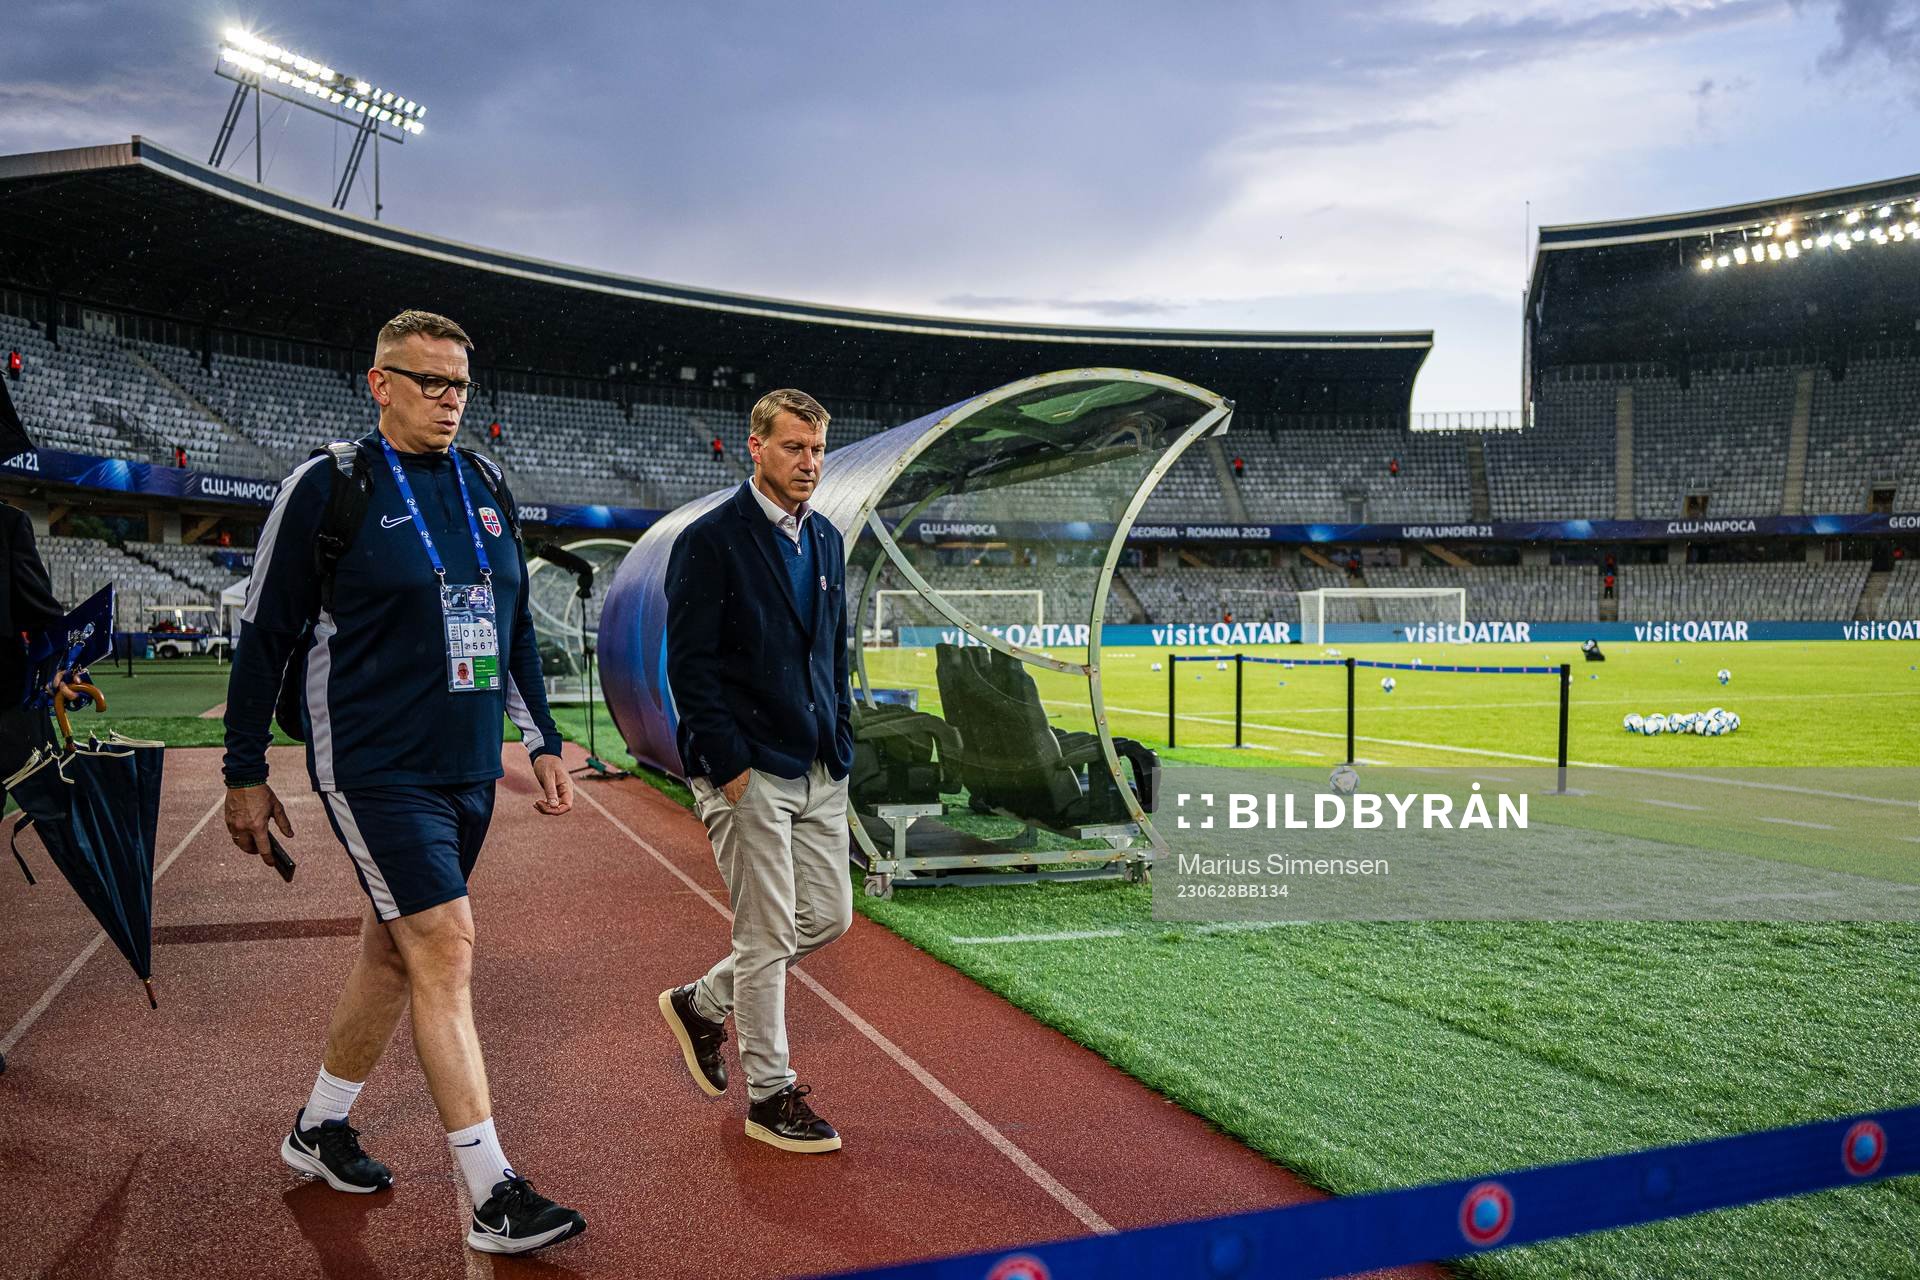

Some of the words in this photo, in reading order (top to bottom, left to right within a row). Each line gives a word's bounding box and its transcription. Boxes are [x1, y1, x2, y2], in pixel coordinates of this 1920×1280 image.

[25, 452, 40, 471] 21
[518, 506, 548, 521] 2023
[919, 523, 997, 536] CLUJ-NAPOCA
[1130, 527, 1178, 538] GEORGIA
[1186, 527, 1240, 537] ROMANIA
[1241, 527, 1270, 538] 2023
[1402, 526, 1434, 538] UEFA
[1434, 526, 1477, 537] UNDER
[1478, 525, 1493, 537] 21
[1667, 520, 1756, 534] CLUJ-NAPOCA
